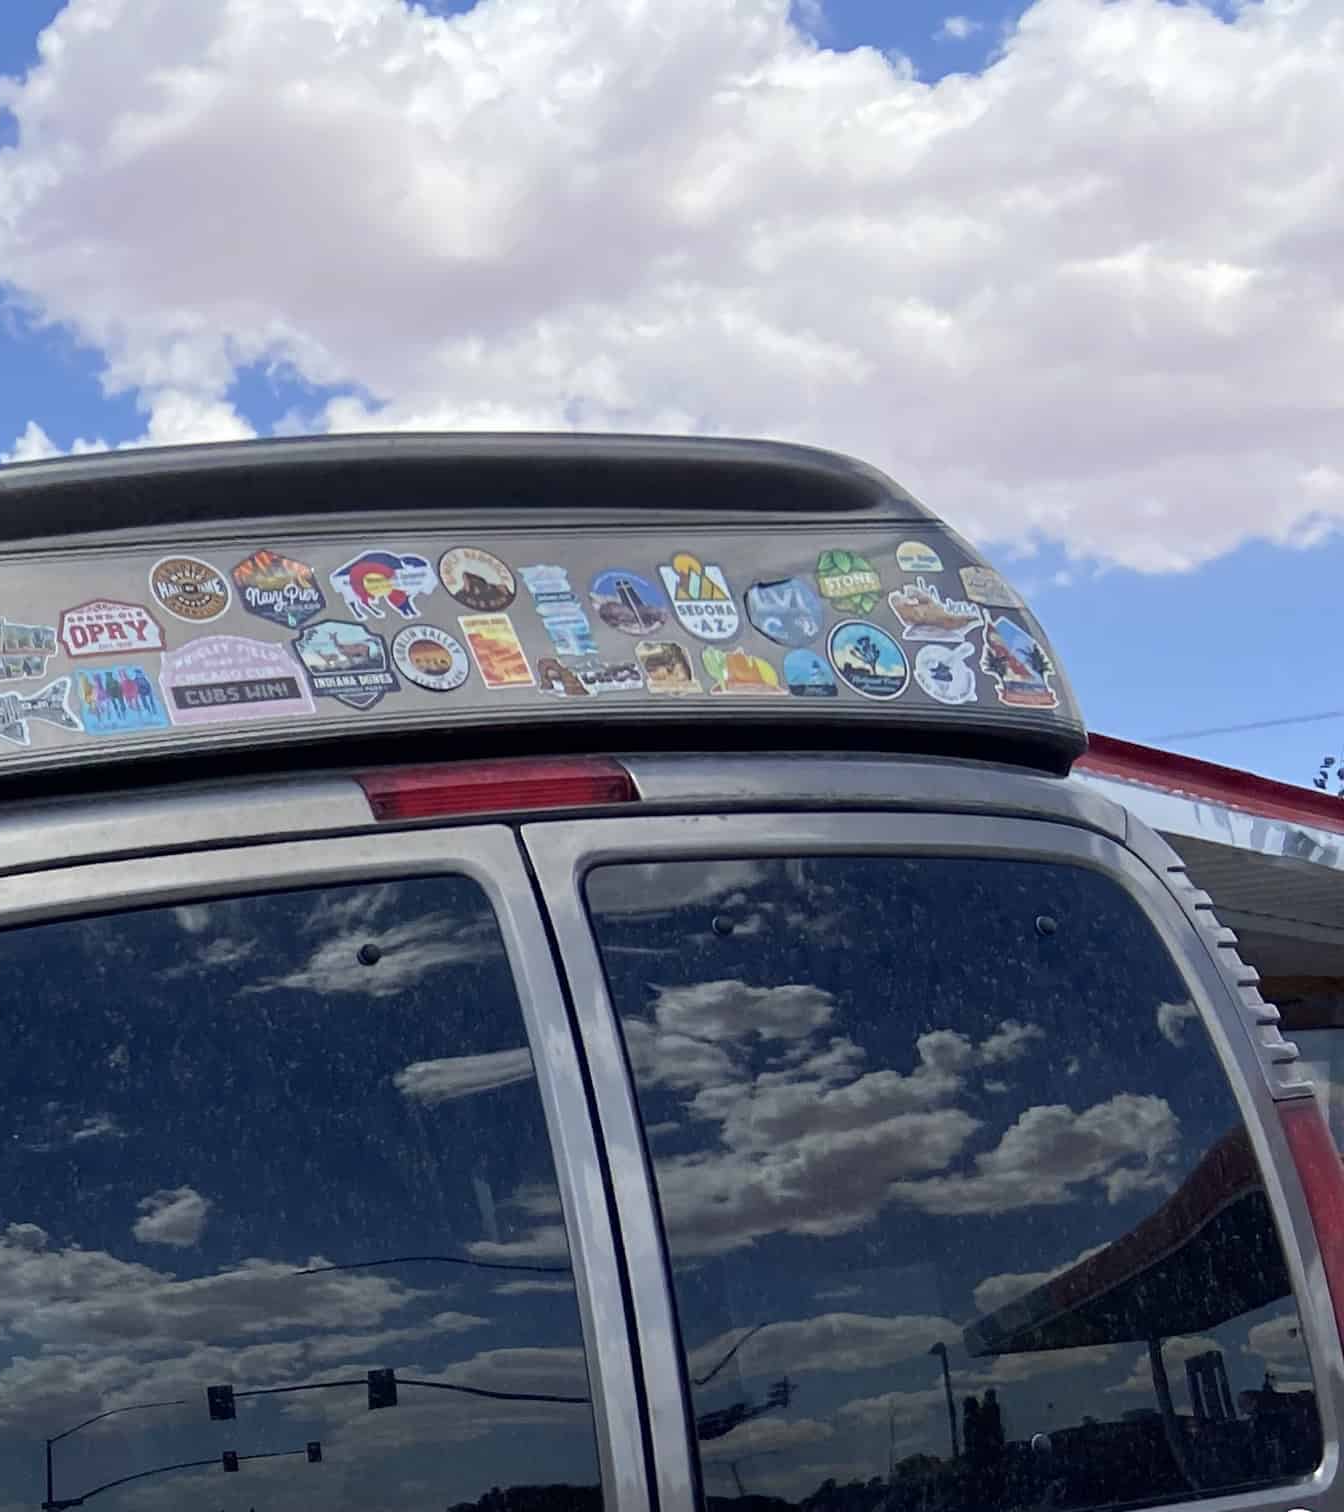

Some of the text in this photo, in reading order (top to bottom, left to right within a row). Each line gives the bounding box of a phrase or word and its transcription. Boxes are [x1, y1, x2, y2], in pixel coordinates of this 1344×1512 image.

[823, 571, 876, 590] STONE
[676, 604, 737, 617] SEDONA
[69, 619, 149, 650] OPRY
[313, 676, 357, 690] INDIANA
[184, 682, 290, 706] CUBS WIN!
